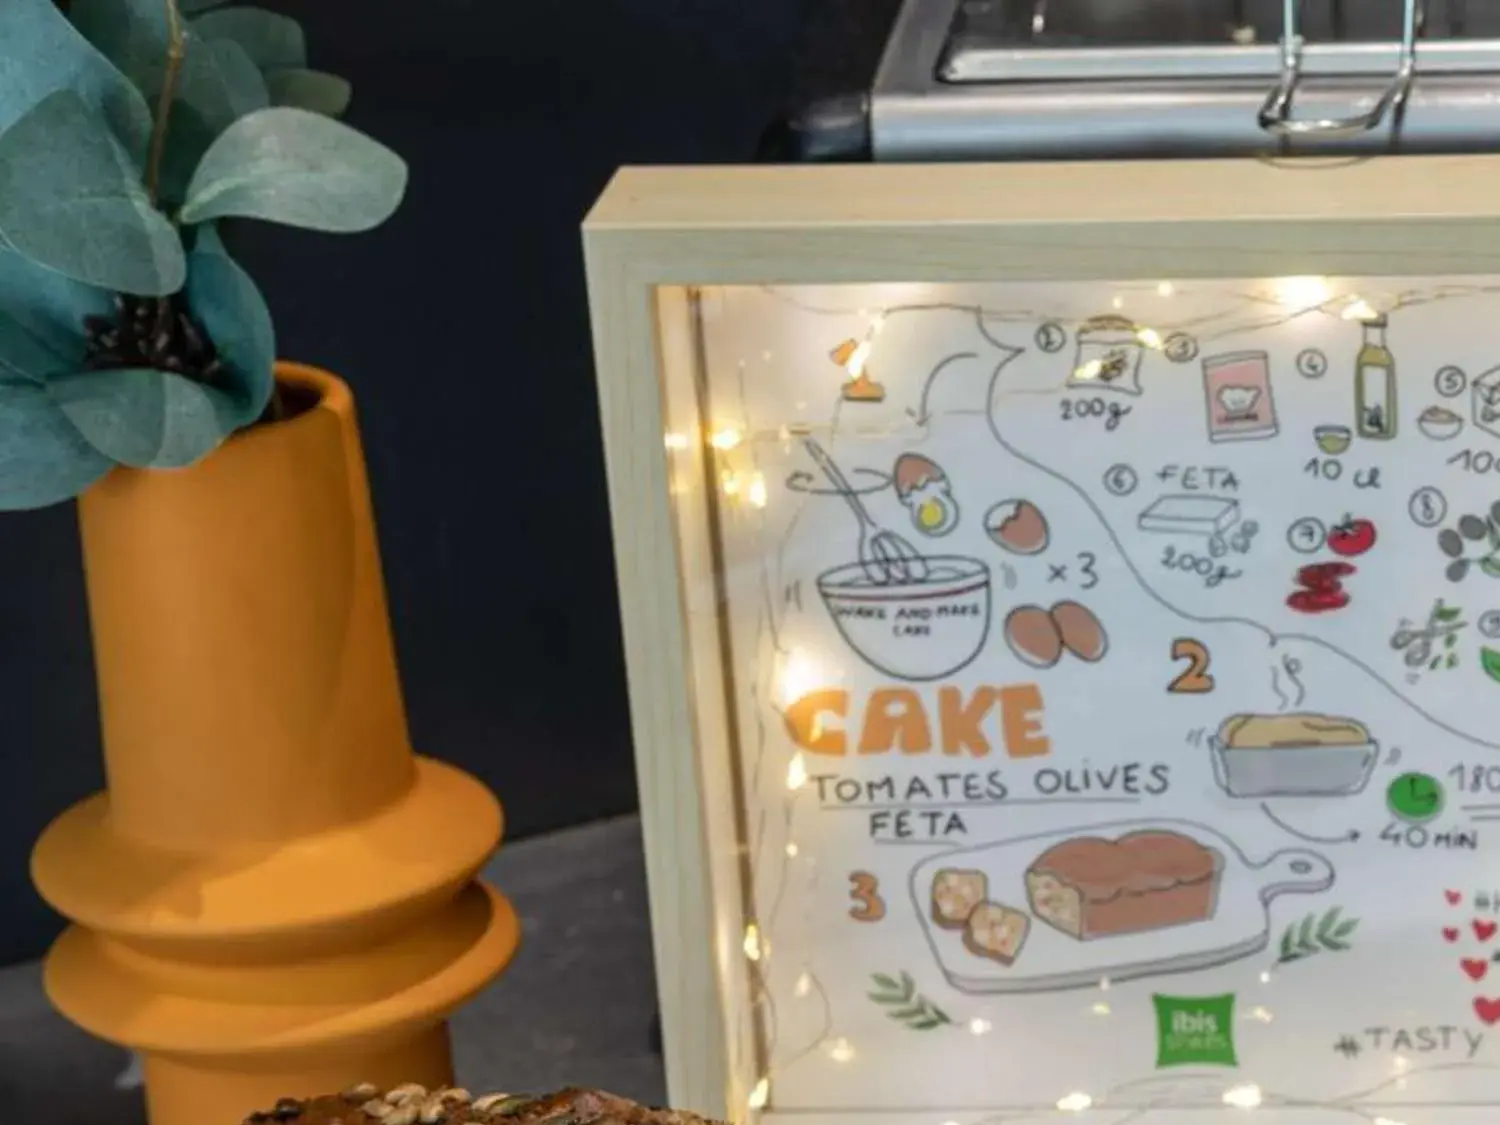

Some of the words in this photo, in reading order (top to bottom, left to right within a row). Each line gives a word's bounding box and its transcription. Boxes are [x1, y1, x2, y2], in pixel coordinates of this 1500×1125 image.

[1060, 397, 1133, 431] 200g
[1156, 464, 1240, 491] FETA
[1161, 544, 1244, 589] 200g
[1166, 637, 1217, 693] 2
[785, 683, 1053, 759] CAKE
[811, 769, 1009, 803] TOMATES
[868, 810, 968, 838] FETA
[1379, 821, 1429, 849] 40
[847, 870, 886, 923] 3
[1171, 1007, 1219, 1033] ibis
[1333, 1024, 1484, 1060] #TASTY
